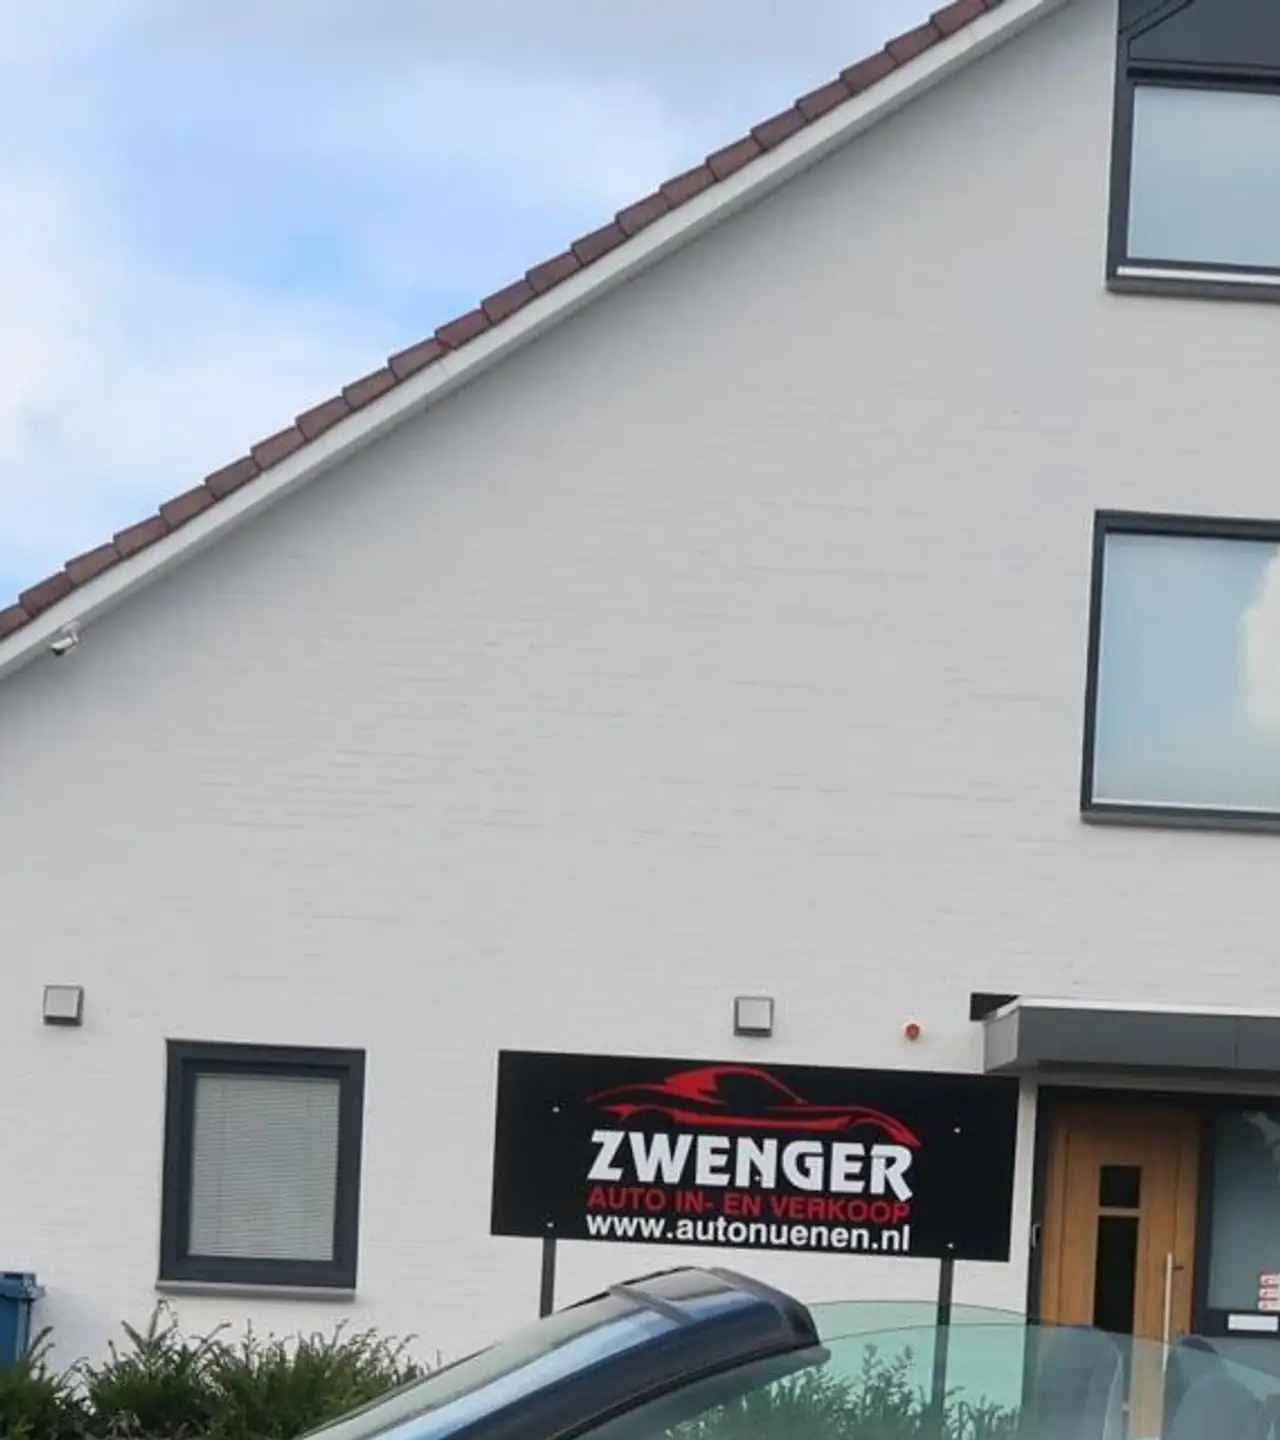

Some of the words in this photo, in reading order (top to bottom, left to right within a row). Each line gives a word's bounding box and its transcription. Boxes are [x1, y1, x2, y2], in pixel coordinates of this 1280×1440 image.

[587, 1129, 913, 1202] ZWENGER
[588, 1187, 666, 1212] AUTO
[676, 1190, 713, 1214] IN-
[723, 1193, 761, 1217] EN
[772, 1196, 910, 1224] VERKOOP
[586, 1213, 910, 1251] www.autonuenen.nl
